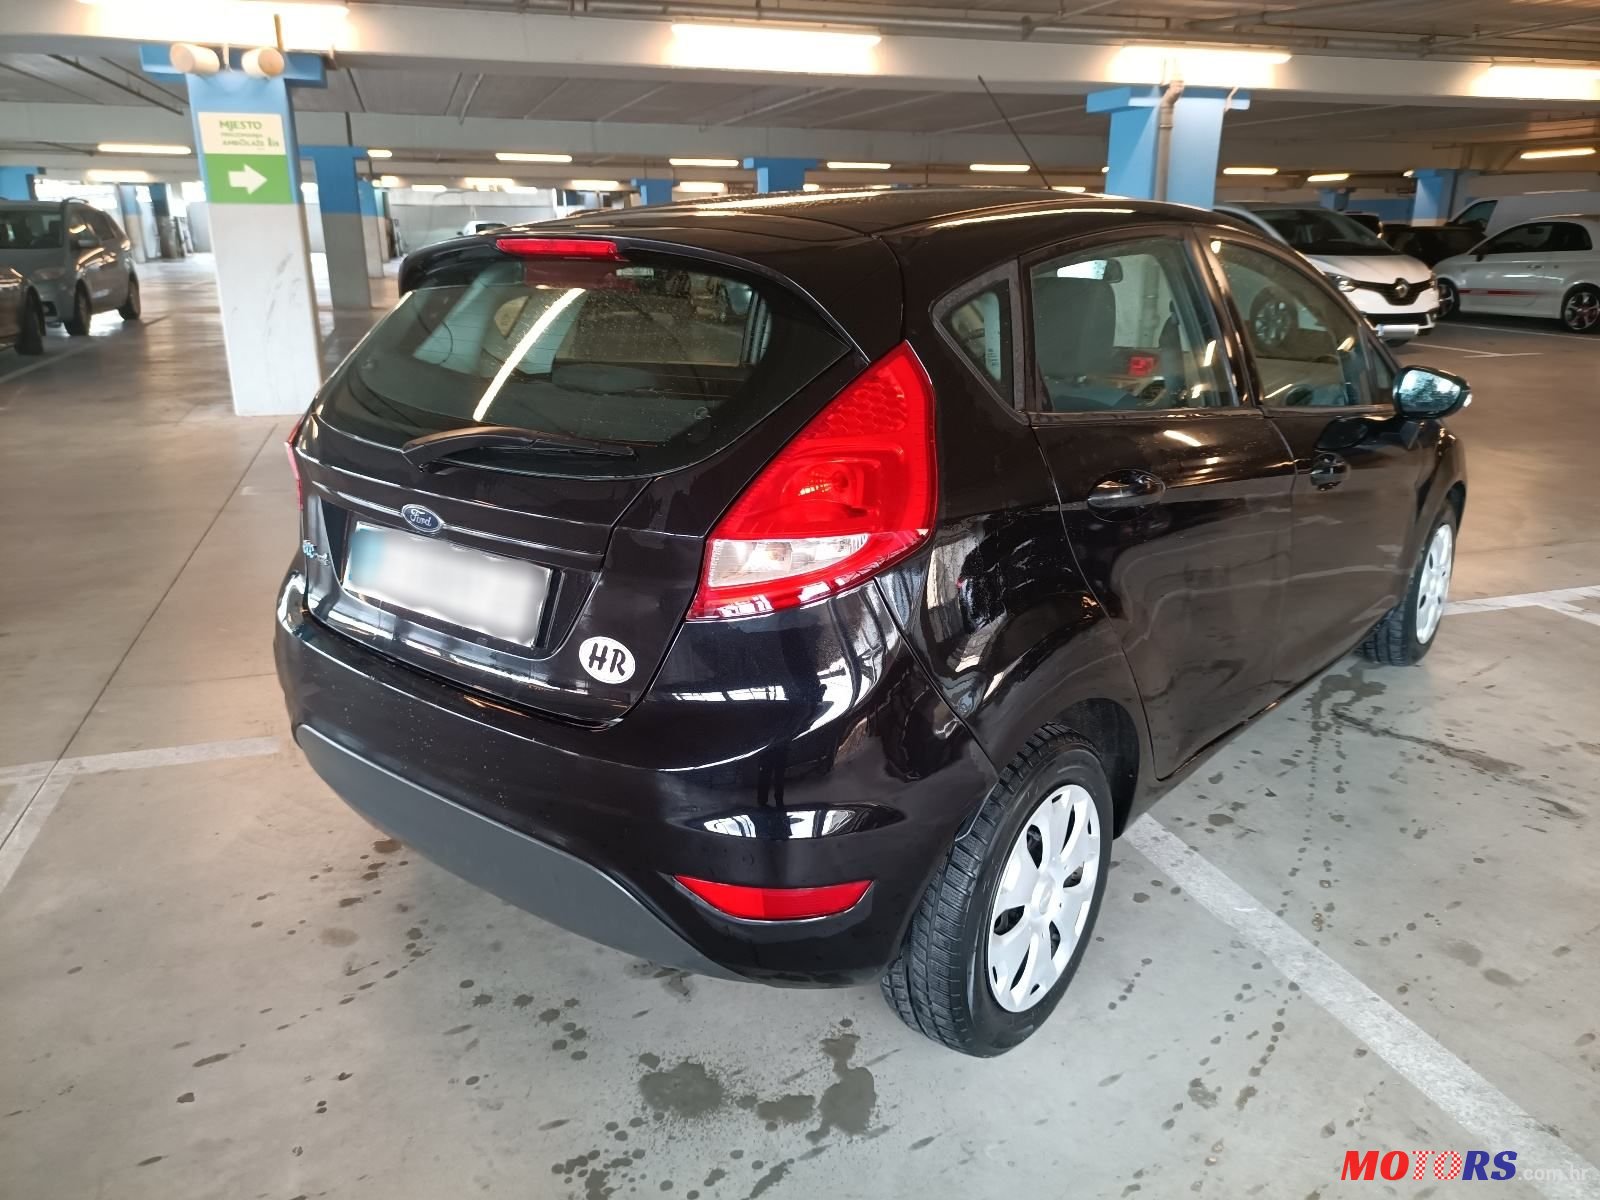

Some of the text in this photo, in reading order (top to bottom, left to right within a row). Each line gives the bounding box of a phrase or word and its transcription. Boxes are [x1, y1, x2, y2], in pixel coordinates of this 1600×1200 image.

[219, 120, 263, 131] MJESTO
[409, 507, 433, 528] Ford
[588, 642, 626, 677] HR
